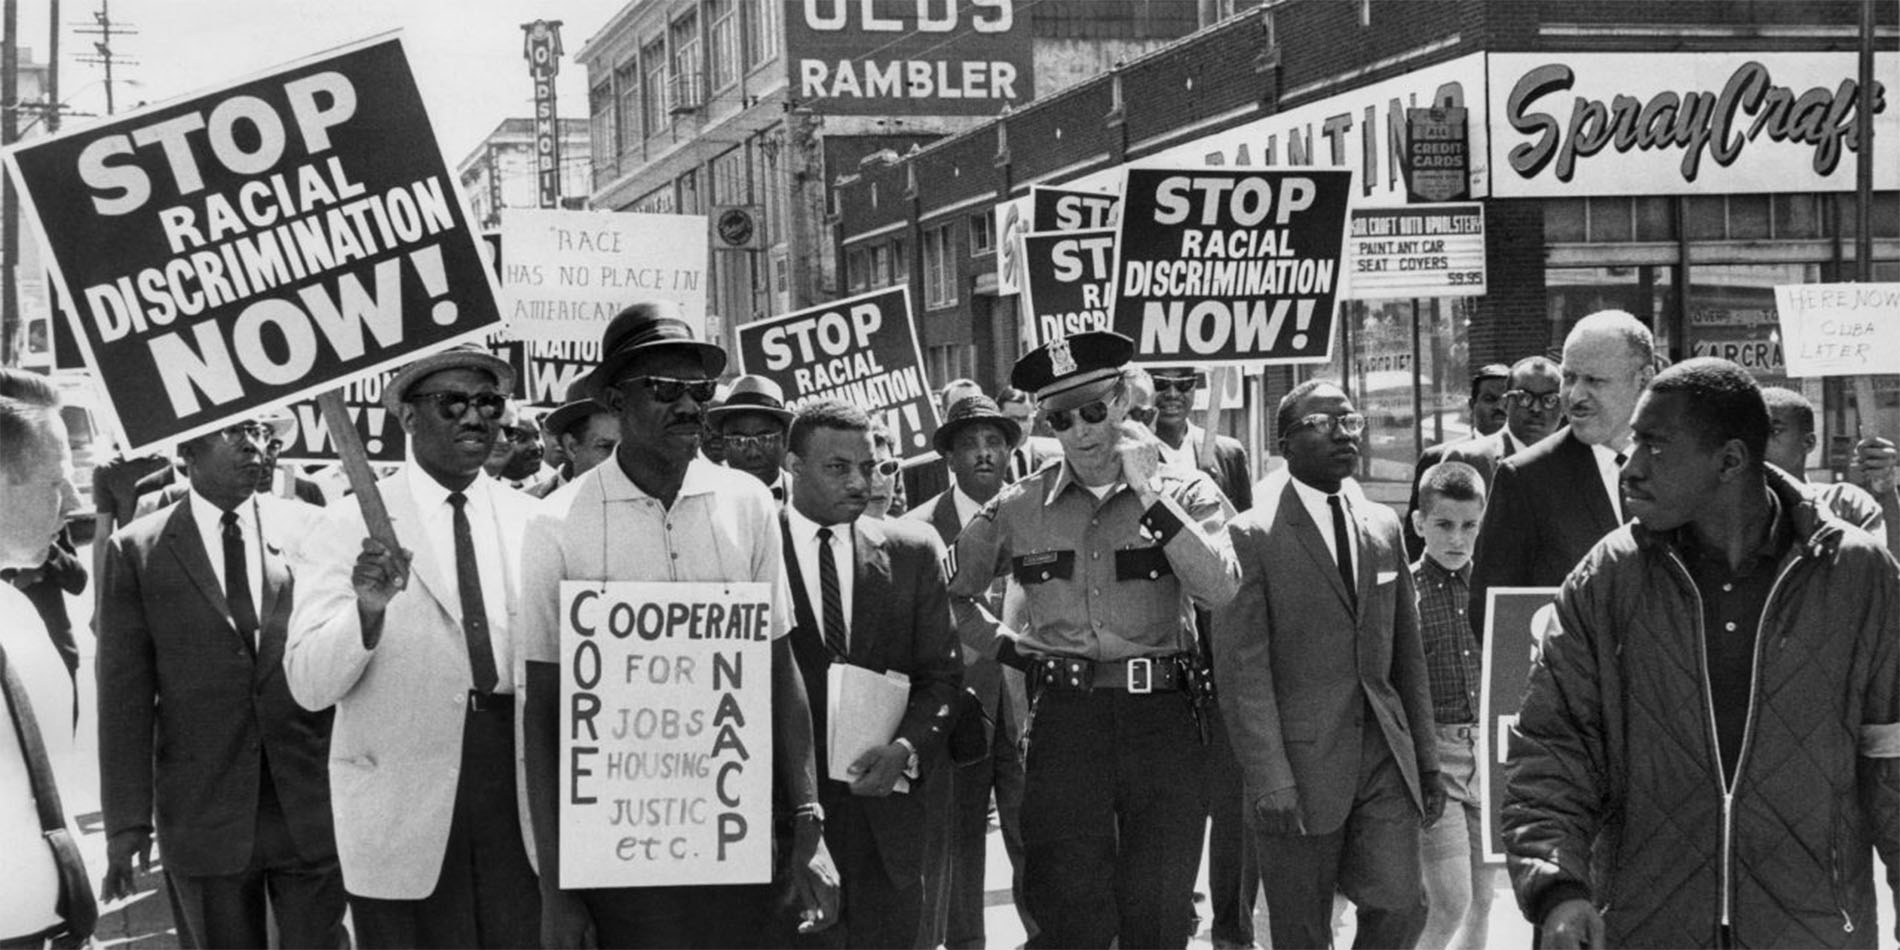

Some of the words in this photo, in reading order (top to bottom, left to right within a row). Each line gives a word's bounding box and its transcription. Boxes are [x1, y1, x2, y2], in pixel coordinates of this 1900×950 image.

[801, 59, 1017, 98] RAMBLER
[78, 71, 358, 217] STOP
[1413, 142, 1462, 154] CREDIT
[1413, 155, 1463, 167] CARDS
[158, 156, 366, 253] RACIAL
[1154, 176, 1316, 227] STOP
[84, 175, 456, 344] DISCRIMINATION
[1181, 229, 1295, 259] RACIAL
[1397, 240, 1419, 255] ANY
[1422, 239, 1445, 253] CAR
[507, 265, 544, 286] HAS
[560, 266, 589, 287] NO
[601, 266, 664, 290] PLACE
[673, 269, 701, 291] IN
[1123, 258, 1334, 297] DISCRIMINATION
[1358, 258, 1388, 272] SEAT
[1399, 256, 1448, 271] COVERS
[1789, 289, 1847, 310] HERE
[1851, 288, 1900, 310] NOW
[147, 243, 459, 419] NOW!
[761, 303, 882, 371] STOP
[1139, 299, 1317, 355] NOW!
[1821, 319, 1875, 337] CUBA
[1800, 343, 1871, 364] LATER
[794, 350, 884, 395] RACIAL
[626, 654, 697, 685] FOR
[570, 590, 602, 805] CORE
[611, 707, 705, 740] JOBS
[607, 752, 711, 781] HOUSING
[711, 651, 750, 861] NAACP
[609, 797, 707, 827] JUSTIC
[616, 837, 700, 861] etc.
